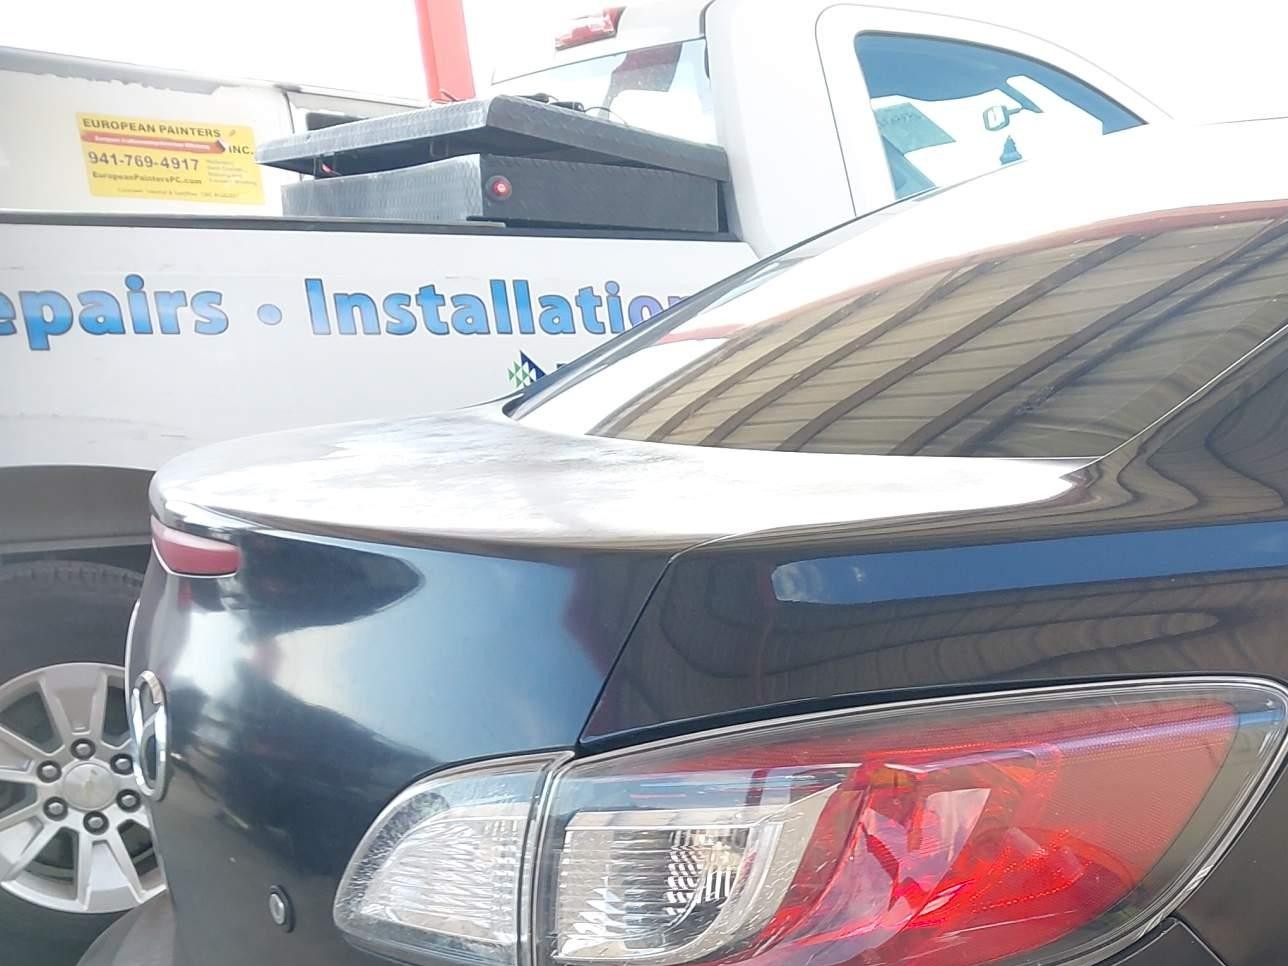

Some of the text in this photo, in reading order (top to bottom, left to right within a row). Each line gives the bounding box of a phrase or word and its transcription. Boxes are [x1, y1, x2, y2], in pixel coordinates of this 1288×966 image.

[83, 118, 221, 138] EUROPEAN PAINTERS
[228, 145, 254, 155] INC.
[88, 151, 199, 170] 941-769-4917
[304, 278, 692, 335] Installatio
